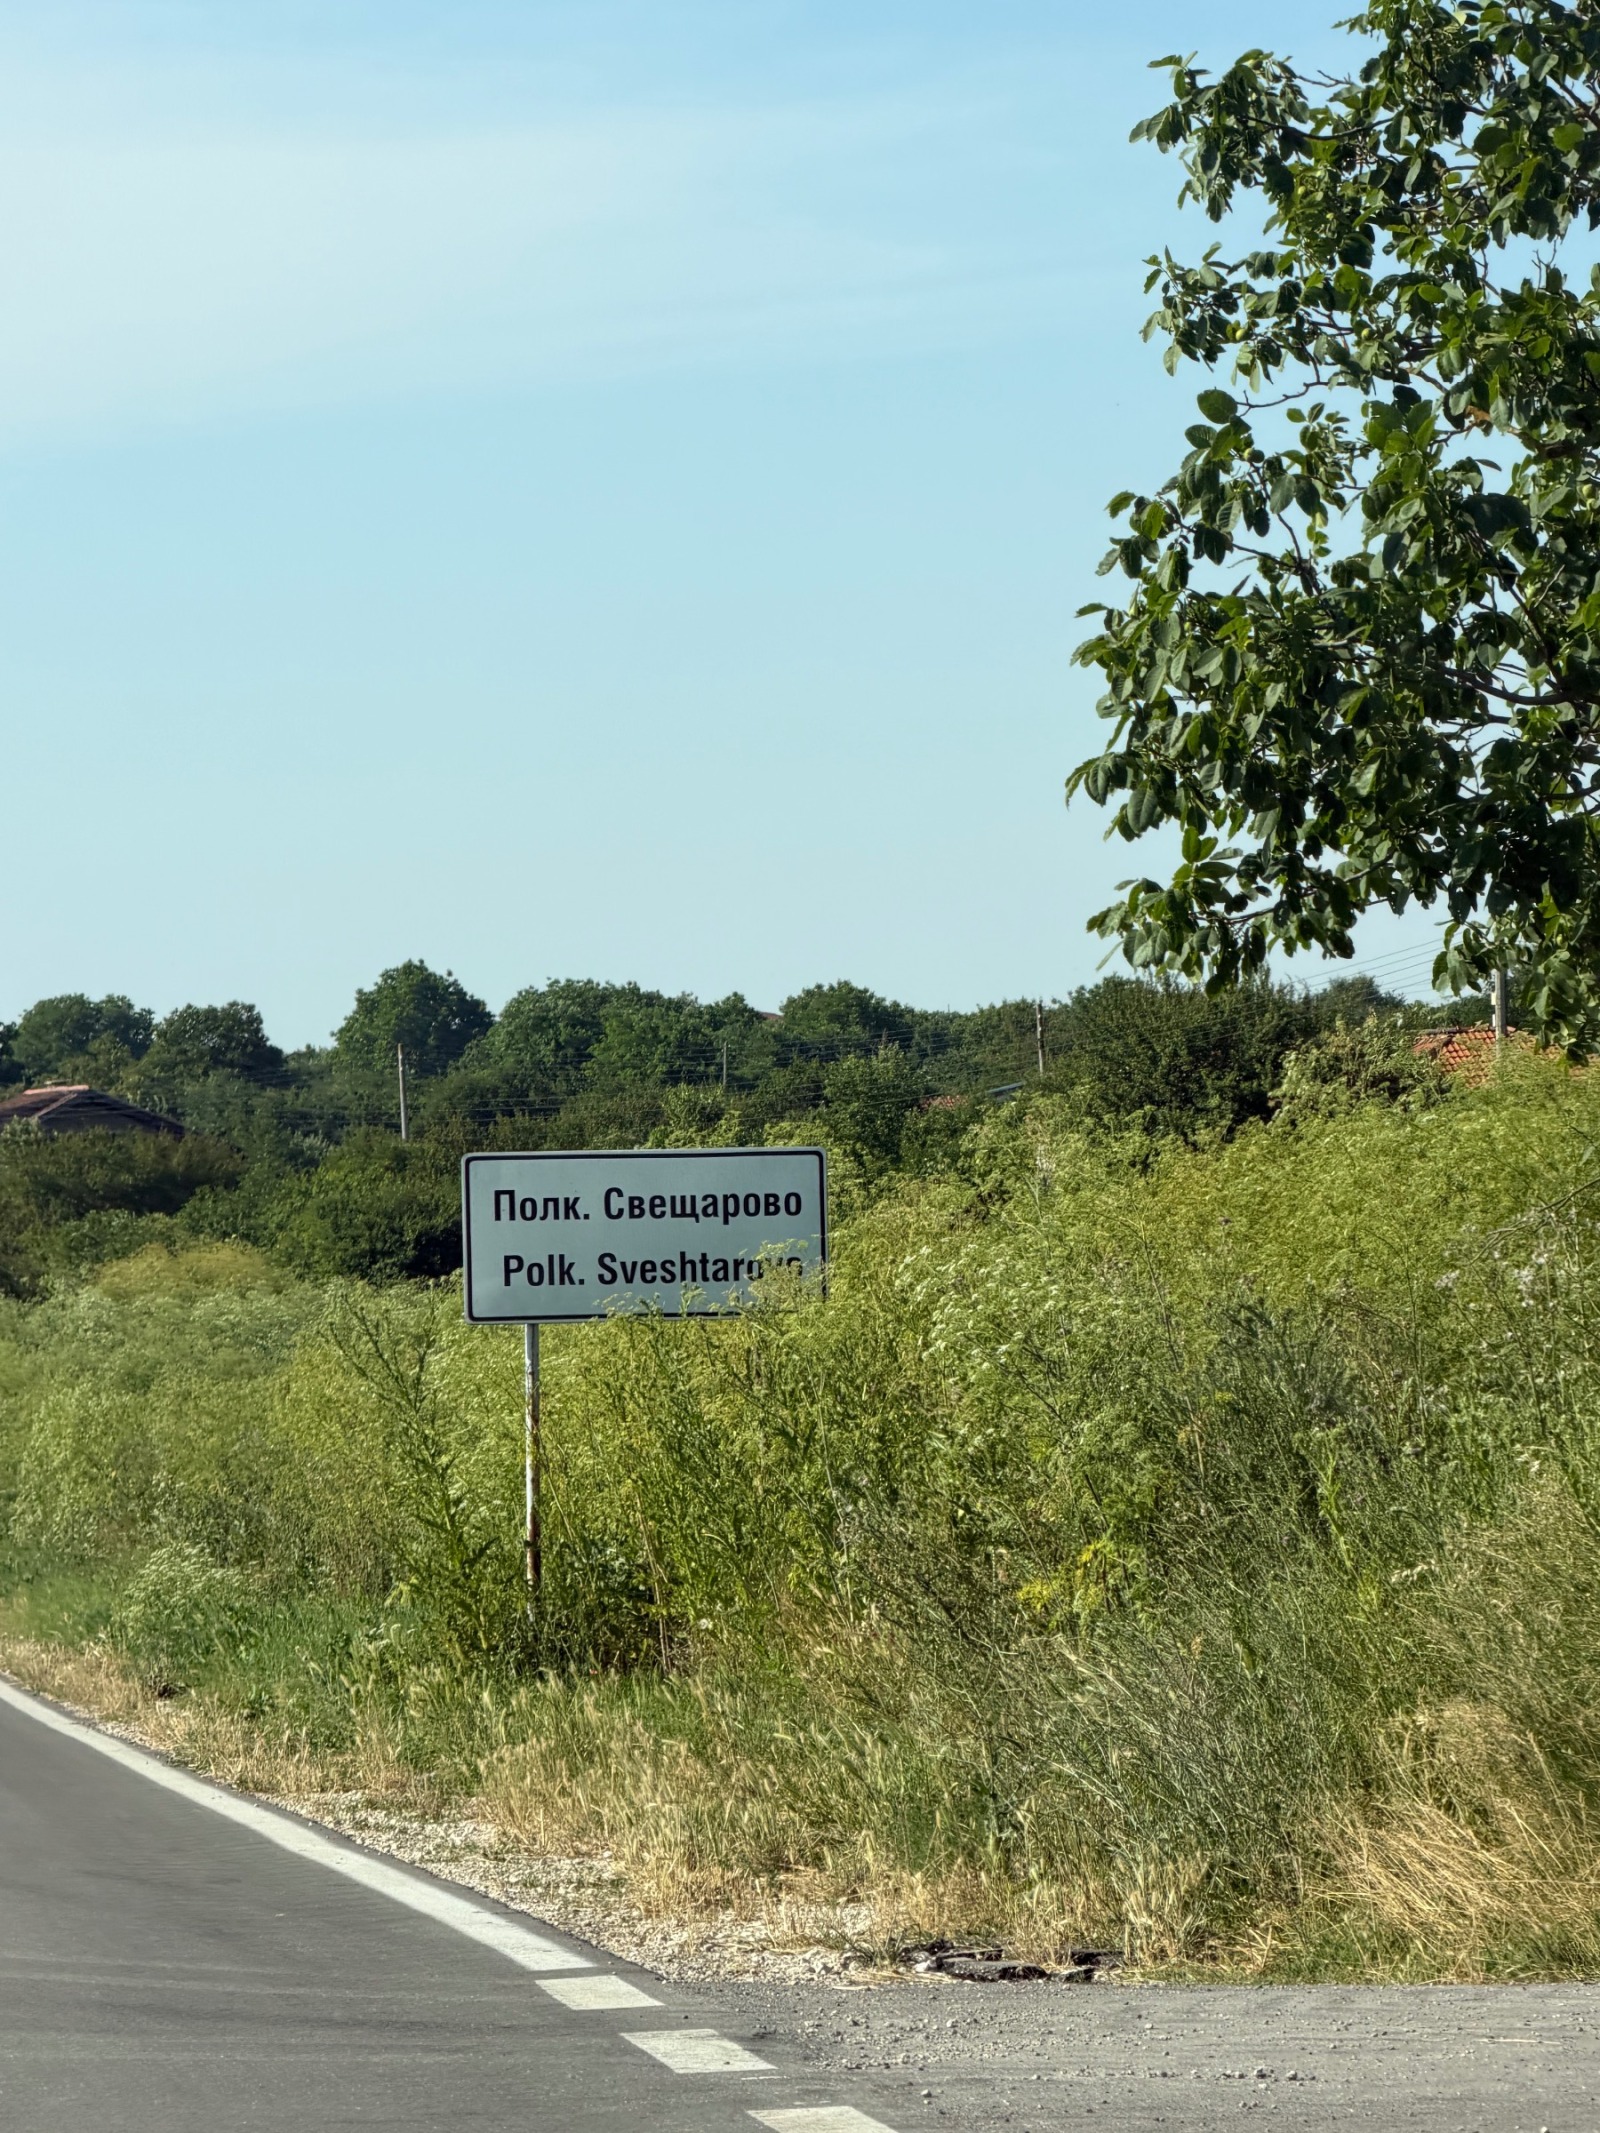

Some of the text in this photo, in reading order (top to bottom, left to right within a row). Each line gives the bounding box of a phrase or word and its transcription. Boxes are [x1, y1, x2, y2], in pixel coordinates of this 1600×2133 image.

[493, 1186, 802, 1225] Полк. Свещарово
[503, 1253, 585, 1287] Polk.
